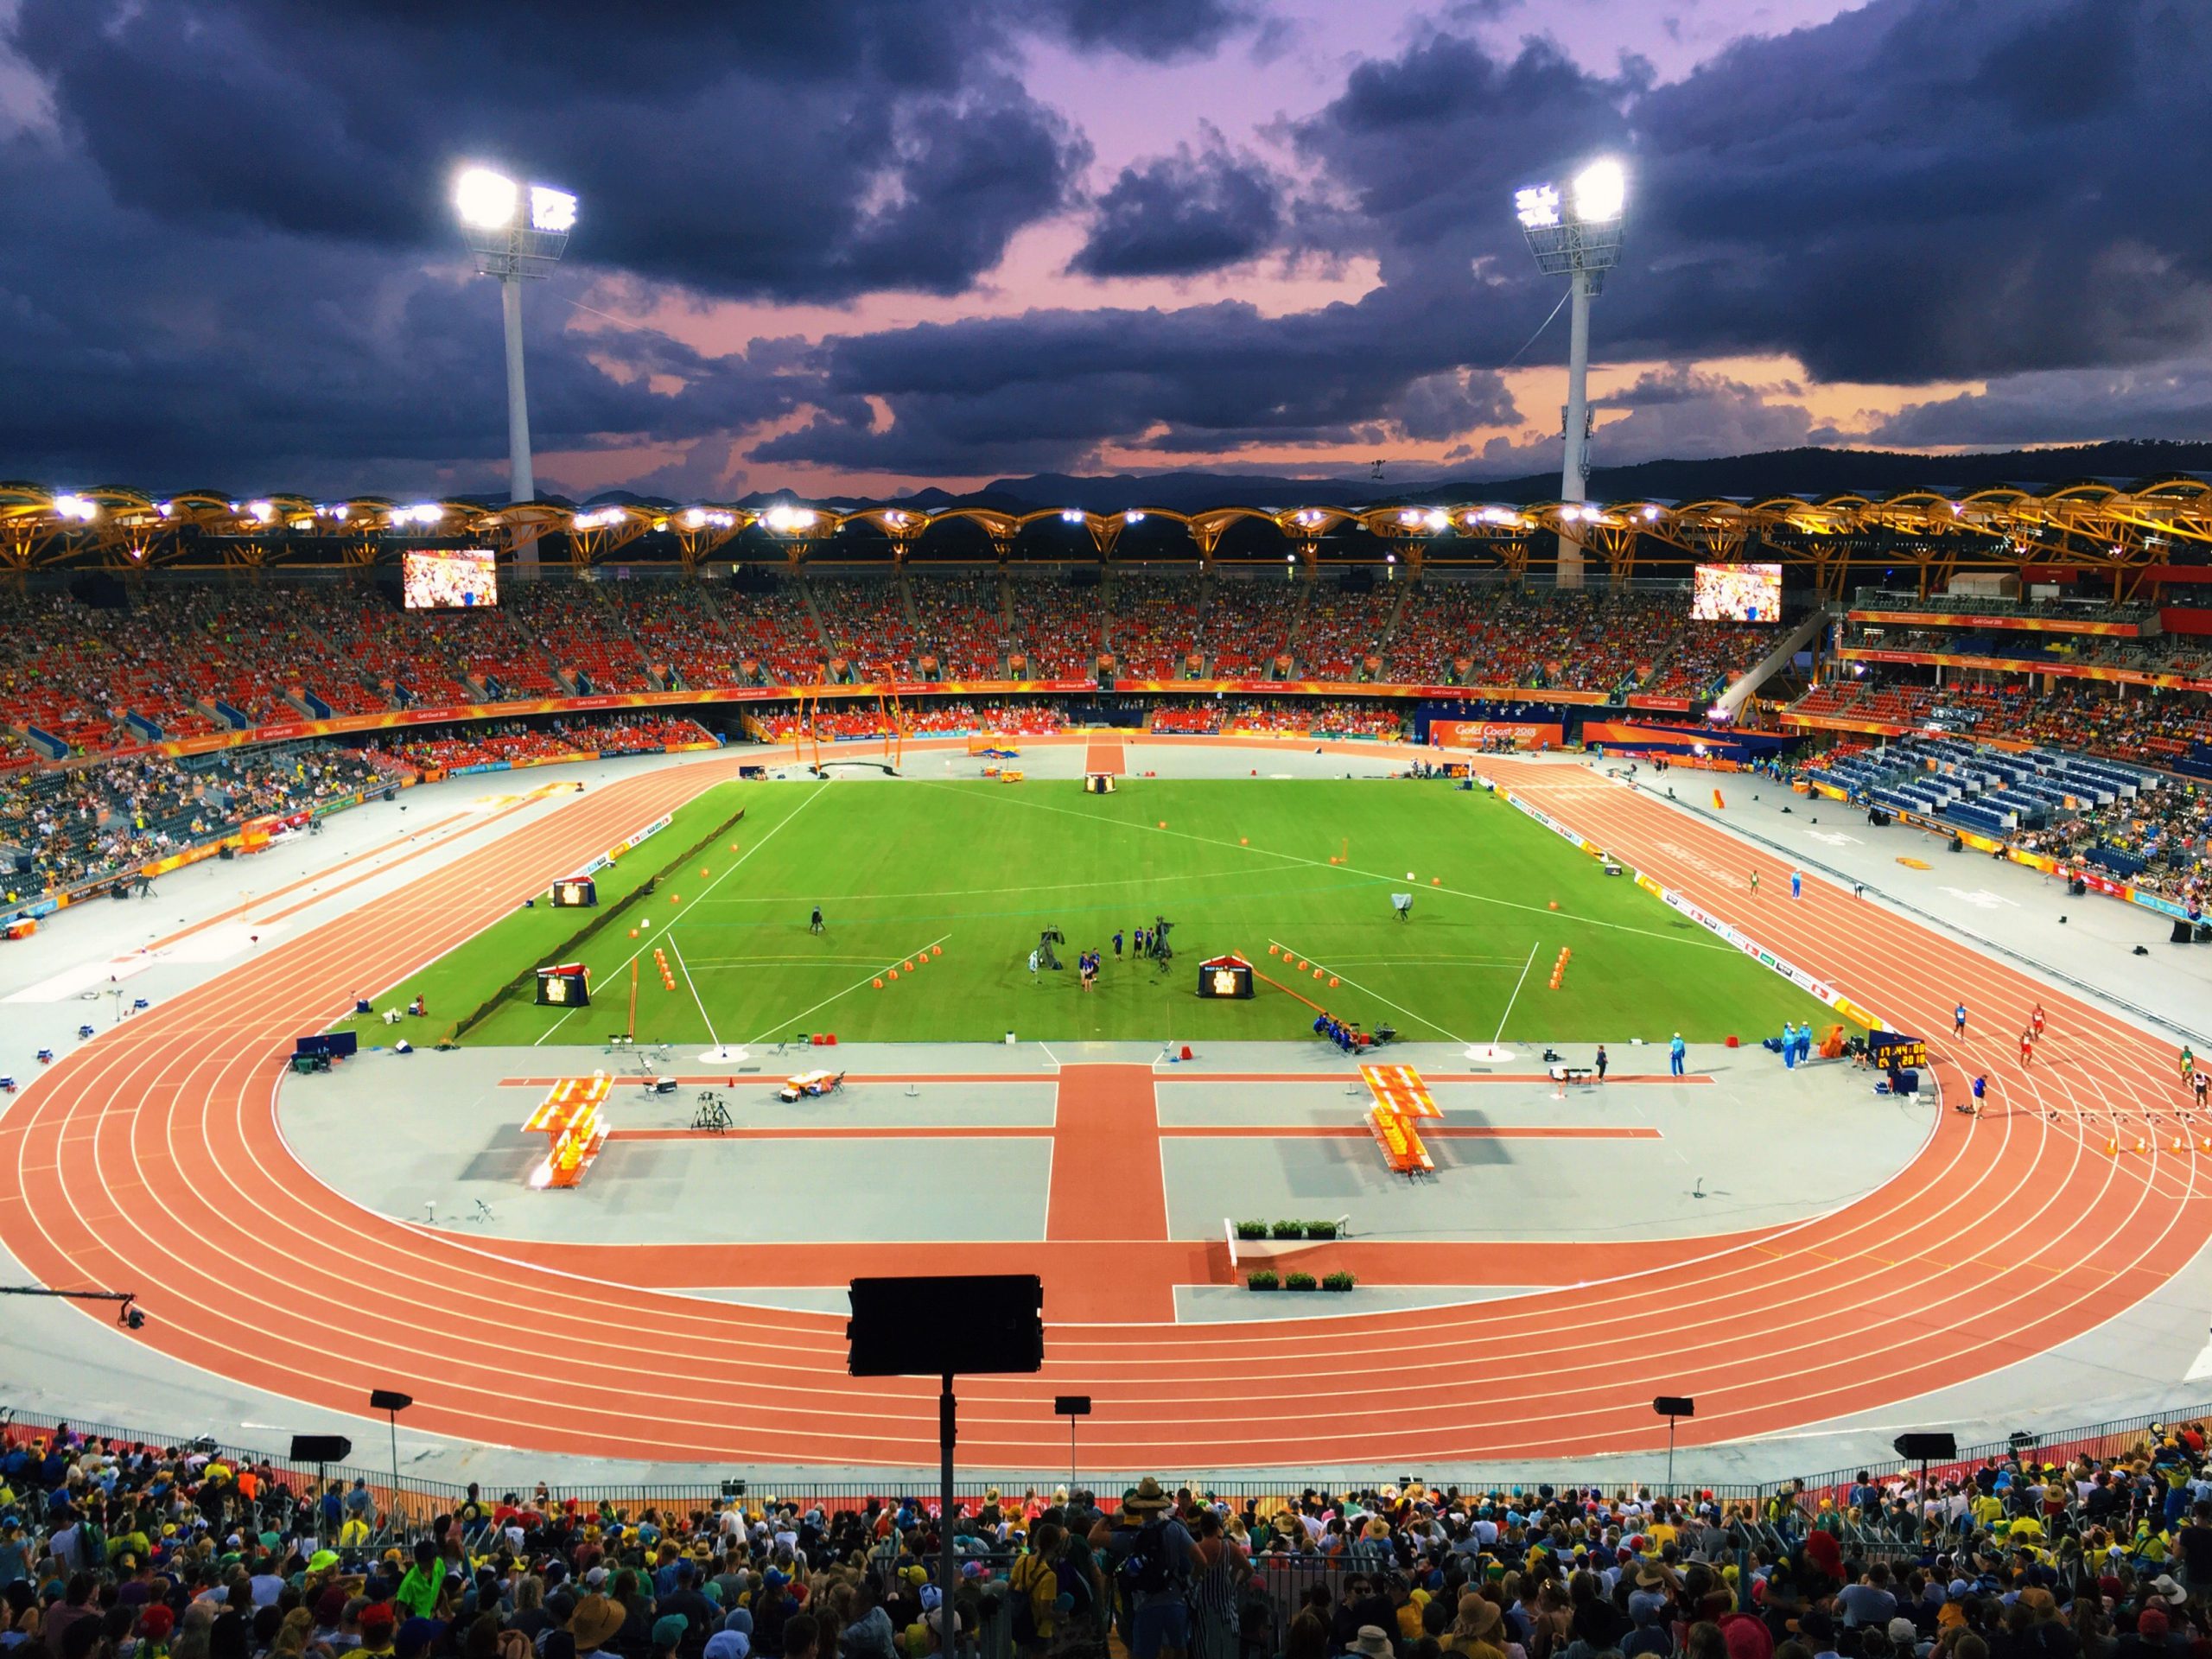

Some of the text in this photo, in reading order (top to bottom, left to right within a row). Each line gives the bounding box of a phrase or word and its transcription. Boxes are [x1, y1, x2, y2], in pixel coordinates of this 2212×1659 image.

[1455, 724, 1536, 737] Gold Coast 2018
[1902, 1054, 1925, 1065] 2018
[2110, 1138, 2115, 1148] 1
[2138, 1137, 2145, 1148] 2
